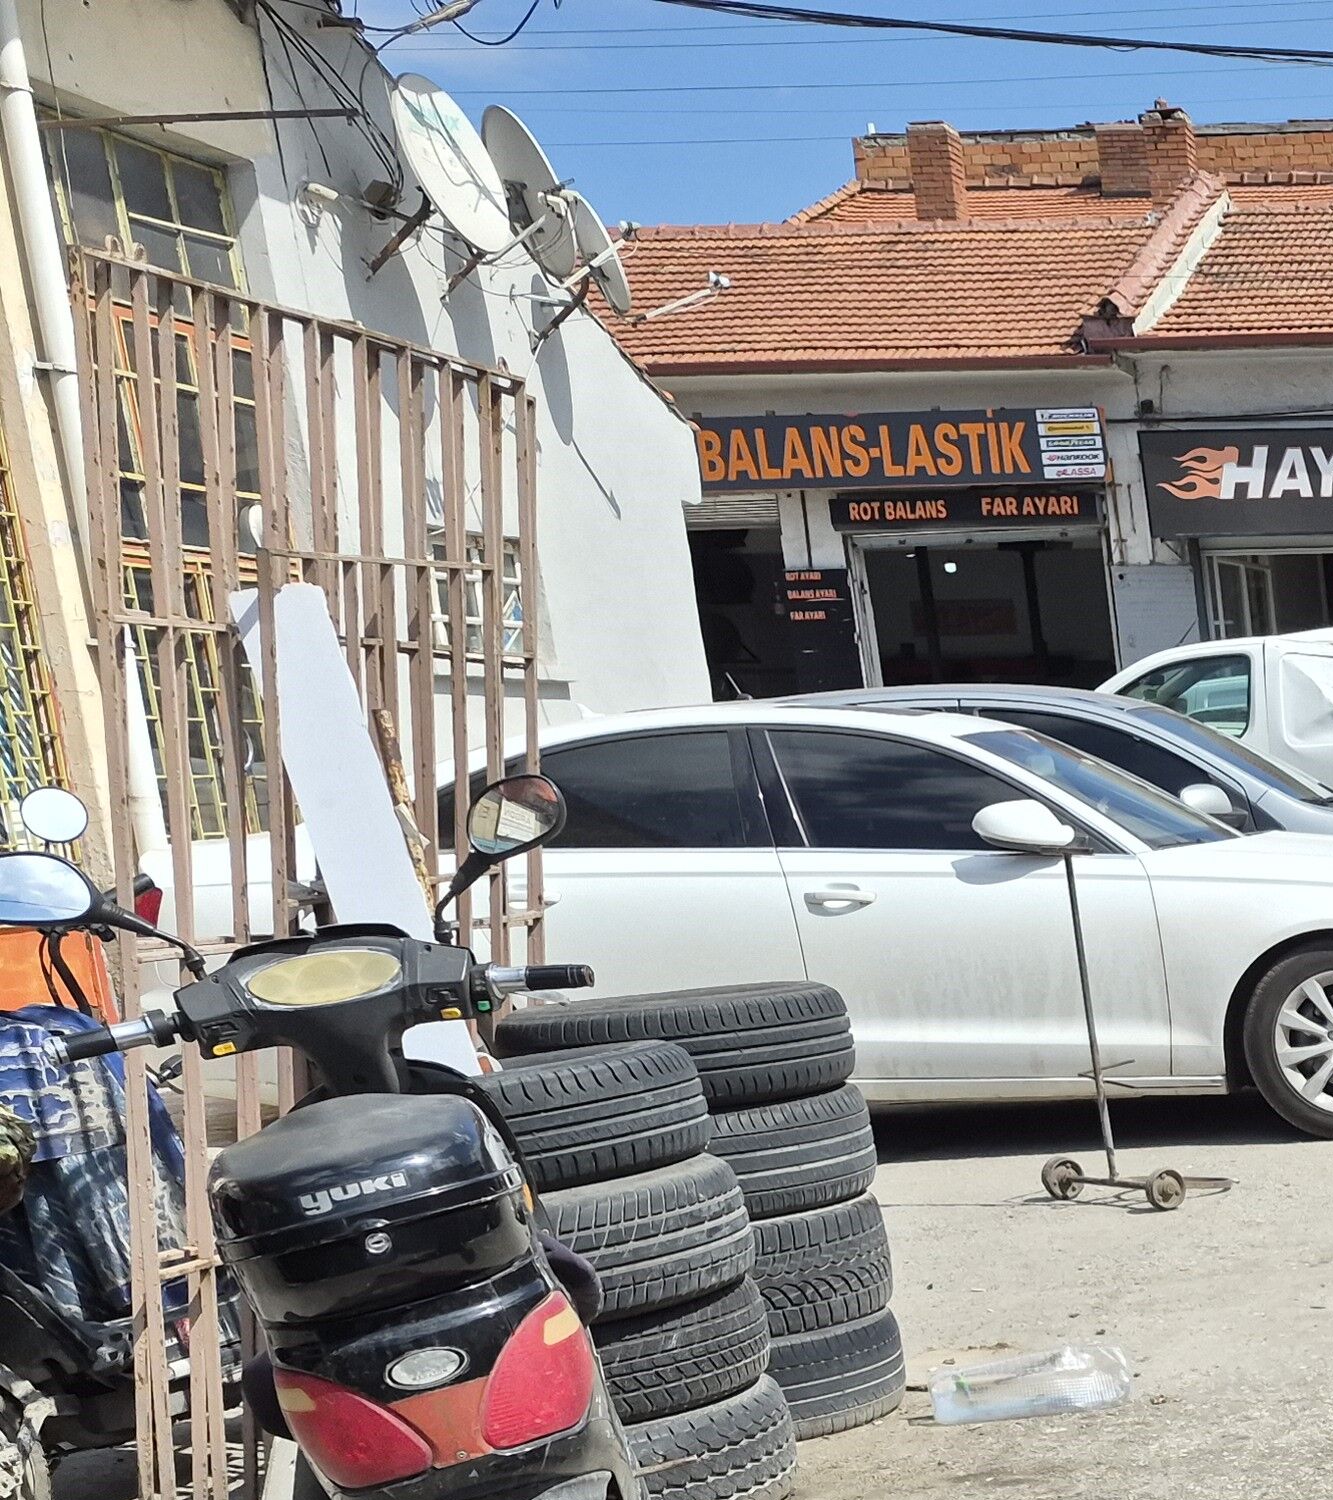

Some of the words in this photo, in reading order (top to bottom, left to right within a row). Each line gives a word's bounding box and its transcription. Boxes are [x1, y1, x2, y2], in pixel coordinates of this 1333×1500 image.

[700, 408, 1032, 482] BALANS-LASTİK
[850, 502, 881, 521] ROT
[884, 499, 948, 520] BALANS
[981, 496, 1018, 516] FAR
[1022, 495, 1079, 515] AYARI
[785, 571, 799, 581] ROT
[800, 571, 822, 581] AYARI
[787, 589, 815, 600] BALANS
[815, 588, 837, 598] AYARI
[790, 611, 804, 621] FAR
[804, 610, 826, 621] AYARI
